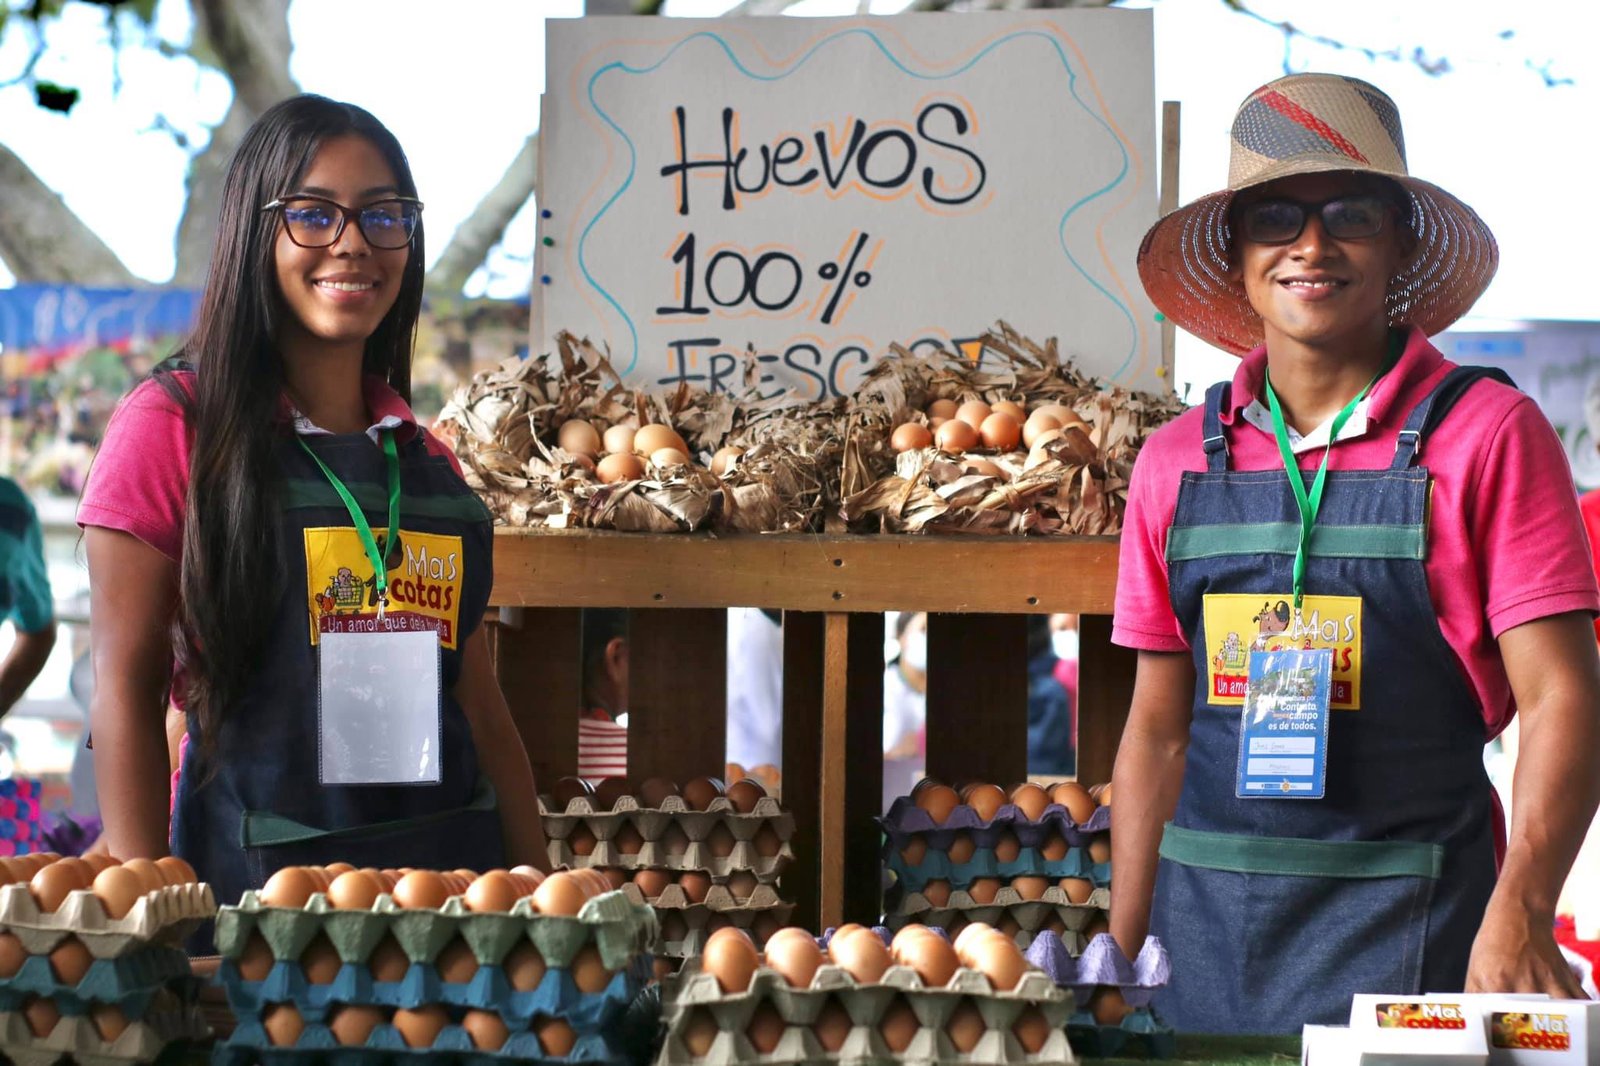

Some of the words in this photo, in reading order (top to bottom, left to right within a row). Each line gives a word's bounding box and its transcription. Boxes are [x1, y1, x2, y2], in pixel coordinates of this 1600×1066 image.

[406, 544, 457, 580] Mas
[390, 575, 454, 611] cotas
[348, 618, 379, 632] amor
[384, 615, 407, 633] que
[1230, 681, 1249, 695] amo
[1279, 721, 1289, 730] de
